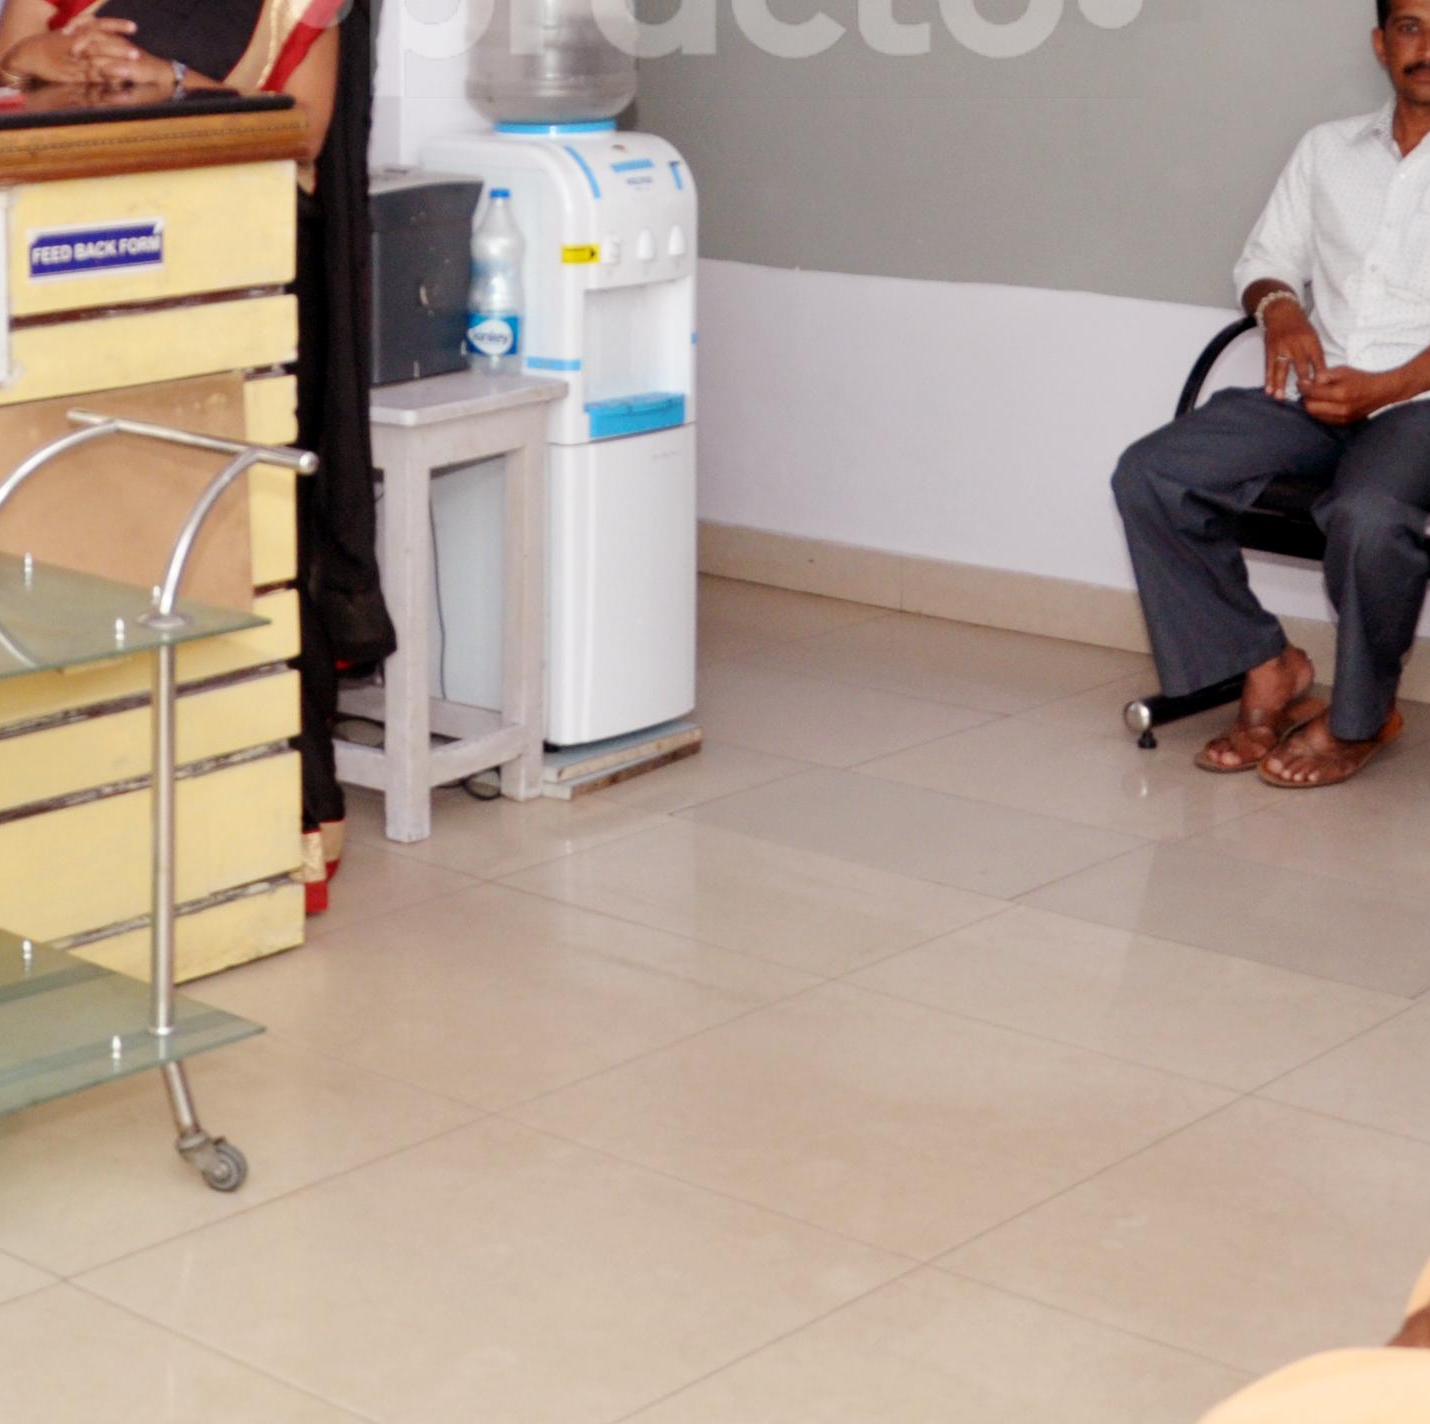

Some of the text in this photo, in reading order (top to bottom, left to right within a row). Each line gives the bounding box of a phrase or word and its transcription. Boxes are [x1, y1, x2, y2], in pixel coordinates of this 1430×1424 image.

[32, 236, 160, 265] FEED BACK FORM
